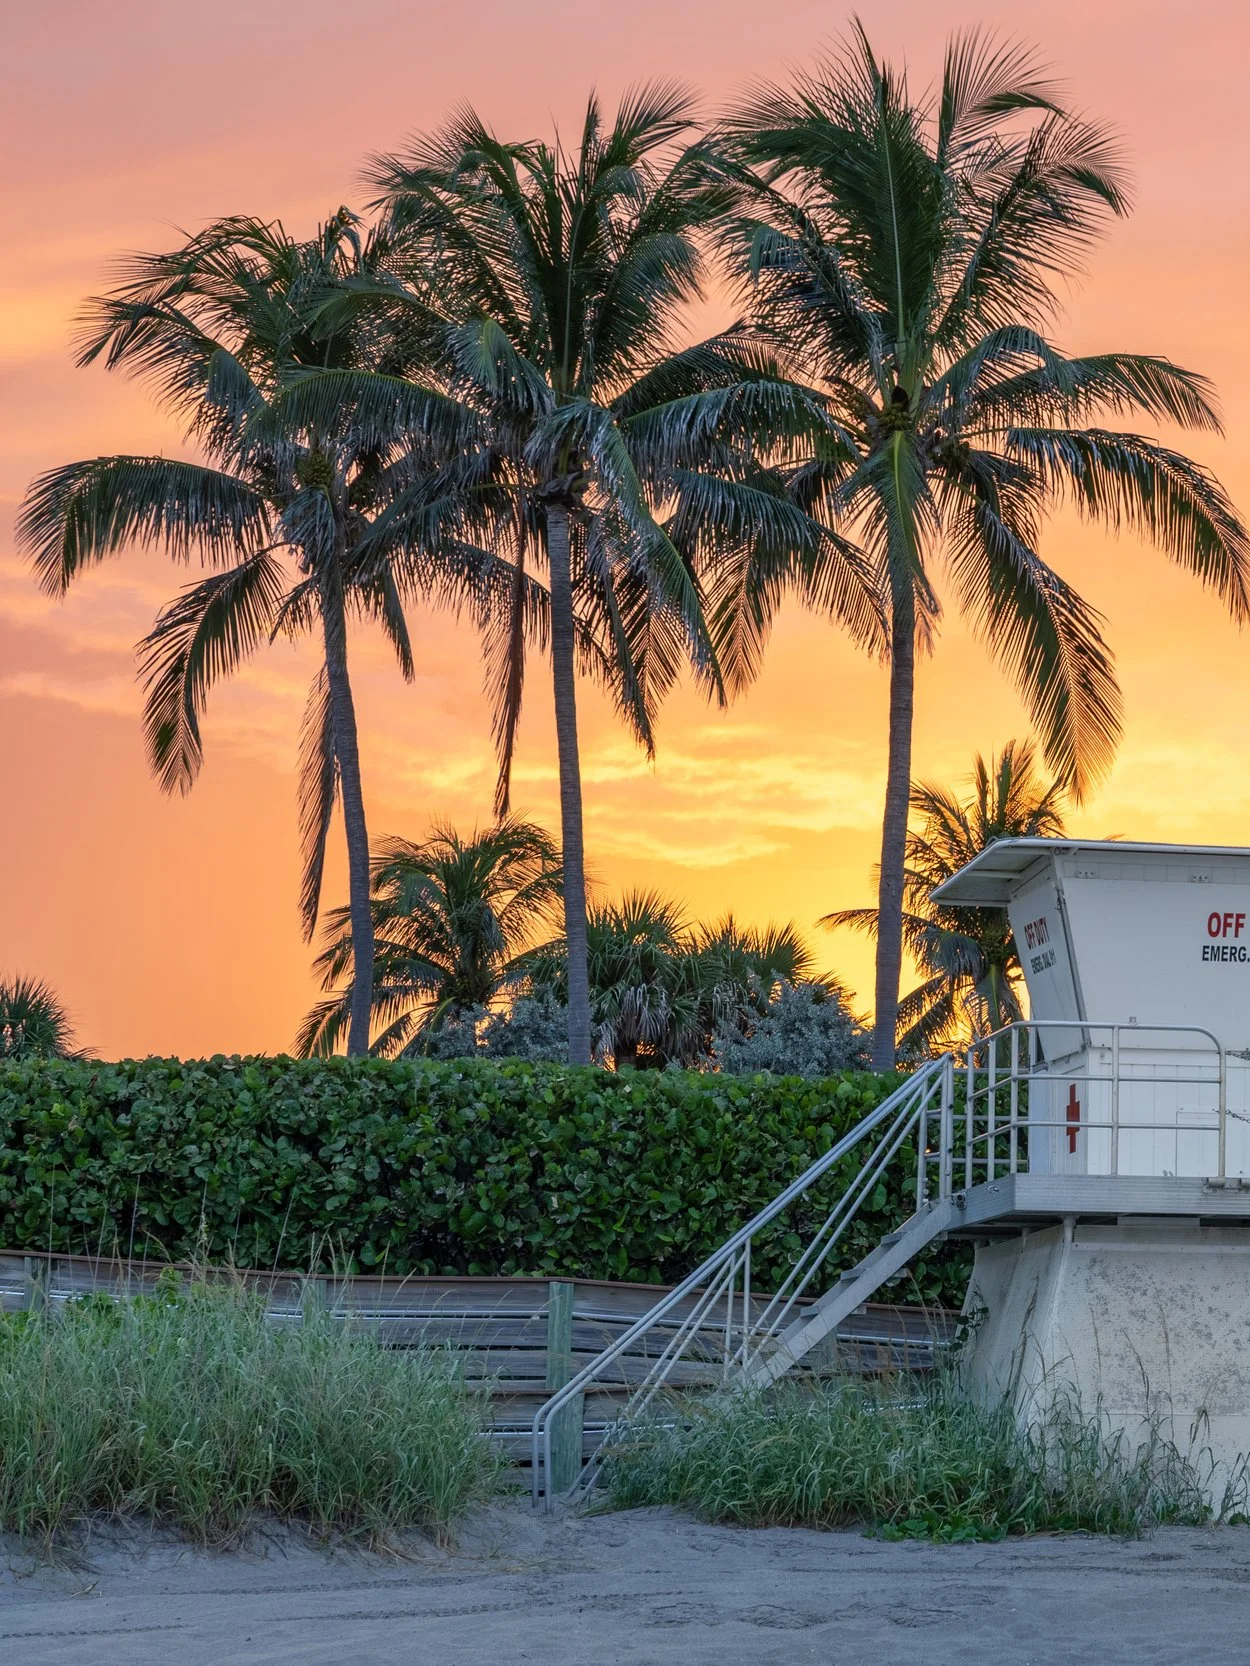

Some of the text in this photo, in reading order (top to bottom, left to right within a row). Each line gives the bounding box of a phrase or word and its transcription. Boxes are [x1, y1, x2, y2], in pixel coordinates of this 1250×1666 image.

[1024, 916, 1050, 950] OFF DUTY
[1207, 912, 1246, 938] OFF
[1202, 945, 1250, 963] EMERG.
